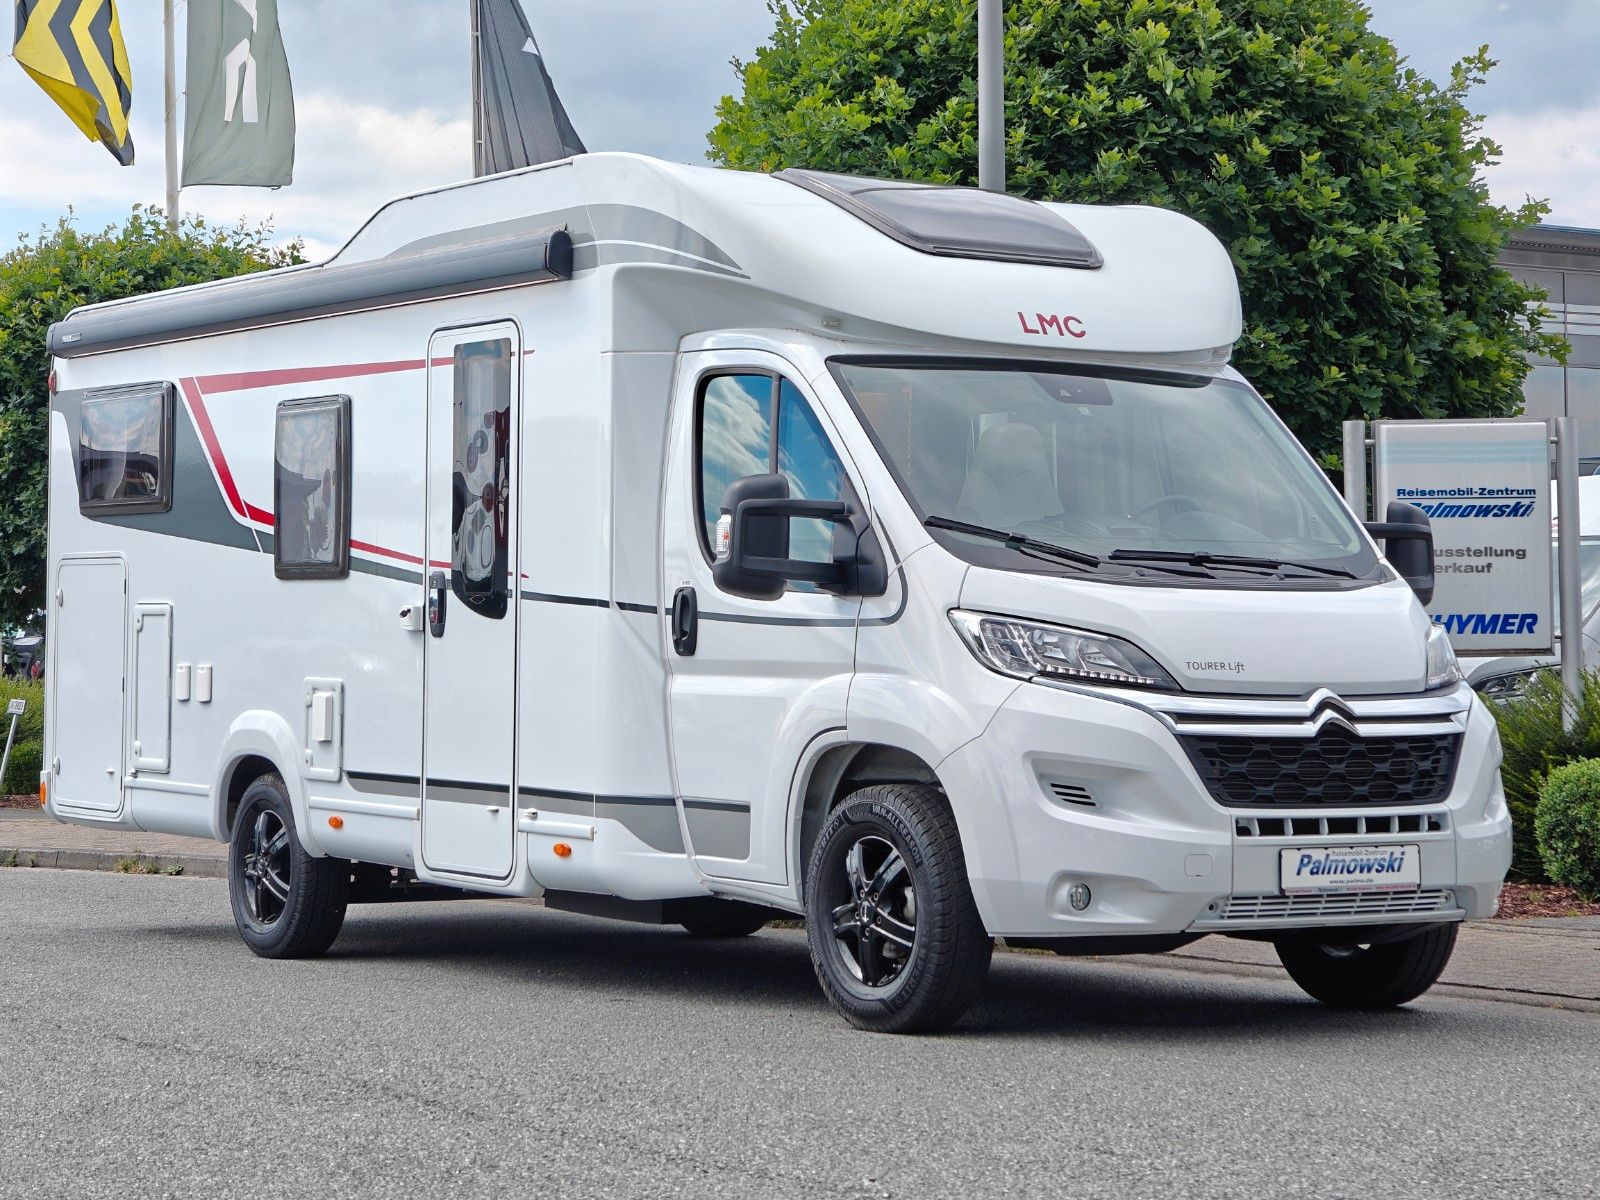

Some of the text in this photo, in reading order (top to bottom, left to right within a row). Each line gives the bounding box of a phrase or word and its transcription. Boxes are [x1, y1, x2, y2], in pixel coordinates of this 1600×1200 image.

[1017, 311, 1087, 338] LMC
[1397, 487, 1536, 497] Reisemobil-Zentrum
[1409, 501, 1535, 518] almowski
[1434, 546, 1526, 559] usstellung
[1434, 562, 1492, 573] erkauf
[1186, 661, 1245, 673] TOURER Lift
[1296, 851, 1406, 876] Palmowski
